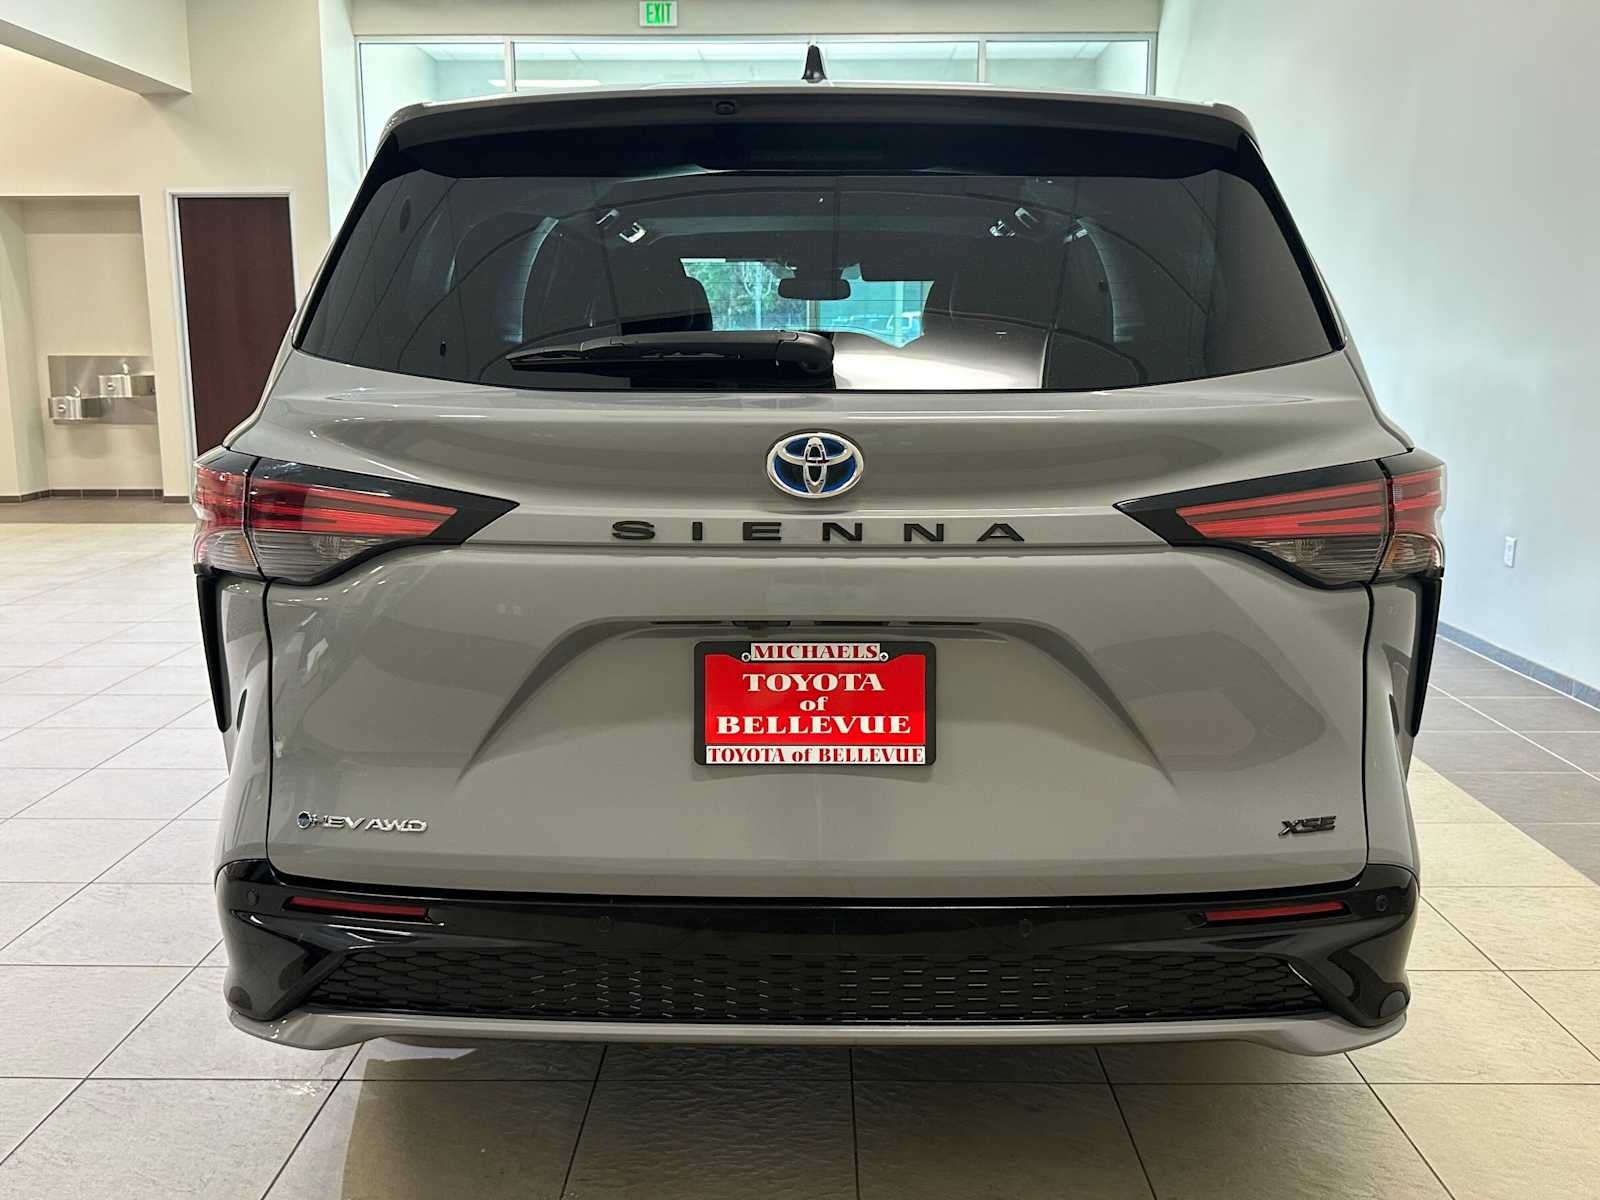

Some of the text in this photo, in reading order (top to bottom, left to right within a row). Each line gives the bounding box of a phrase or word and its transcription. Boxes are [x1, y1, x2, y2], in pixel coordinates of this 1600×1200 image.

[646, 2, 672, 24] EXIT
[611, 520, 1026, 543] SIENNA
[753, 644, 878, 660] MICHAELS
[742, 673, 886, 692] TOYOTA
[799, 696, 829, 712] of
[716, 715, 912, 735] BELLEVUE
[708, 747, 925, 763] TOYOTA of BELLEVUE
[364, 818, 428, 832] AWD
[1278, 815, 1337, 837] XSE
